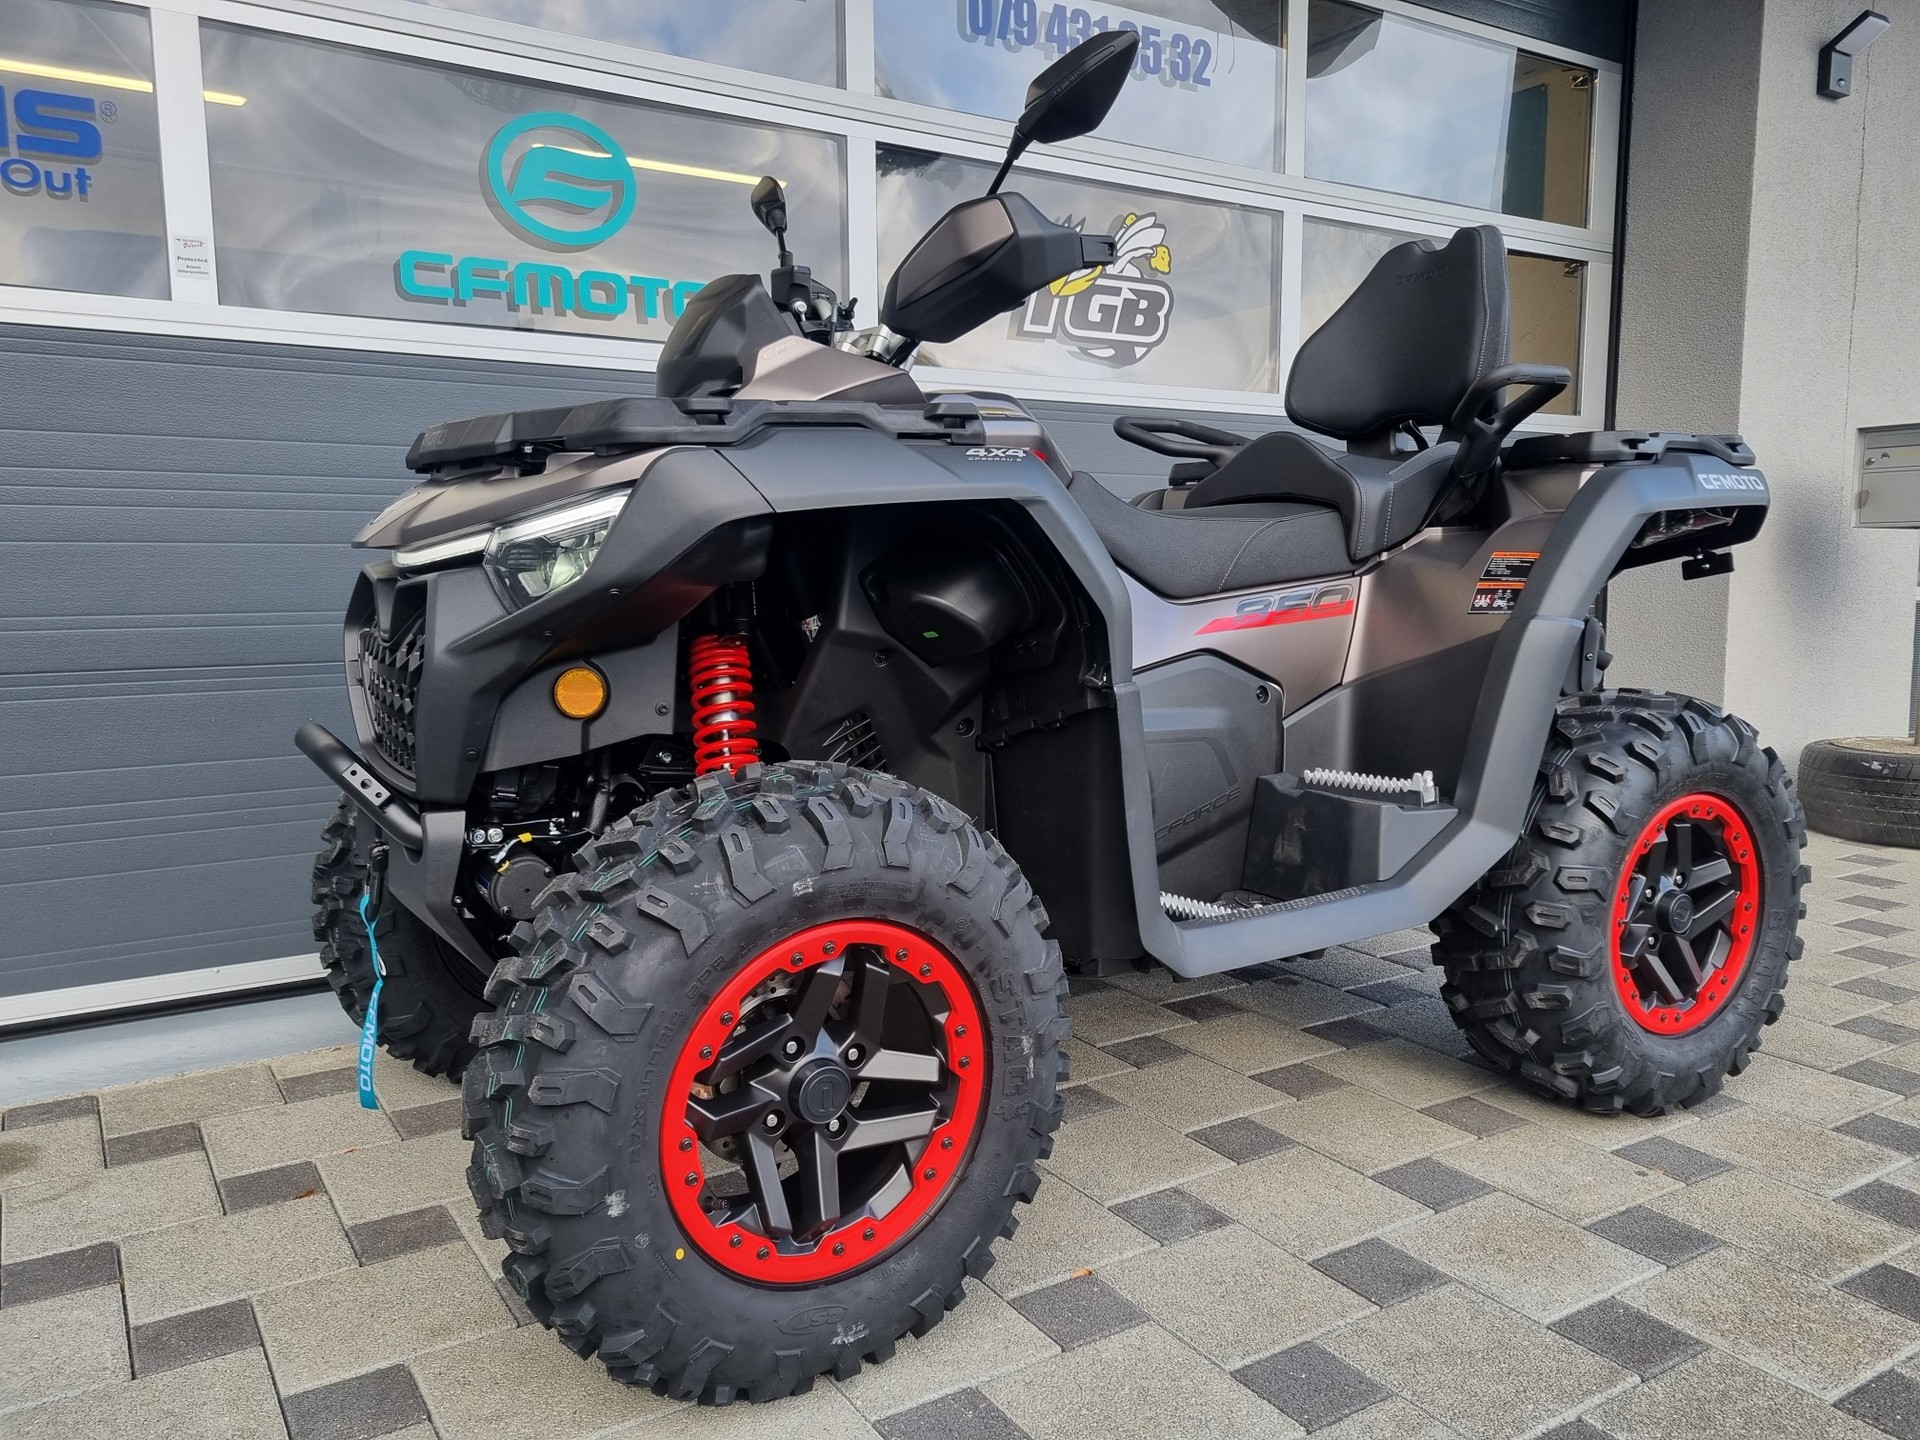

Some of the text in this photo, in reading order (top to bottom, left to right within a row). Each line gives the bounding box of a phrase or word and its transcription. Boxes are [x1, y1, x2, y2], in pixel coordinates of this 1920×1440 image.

[1170, 33, 1212, 87] 32
[763, 338, 798, 360] EPS
[1697, 473, 1766, 491] CFMOTO
[1234, 584, 1354, 626] 850
[1153, 782, 1241, 840] CFORCE
[360, 991, 379, 1093] CFMOTO
